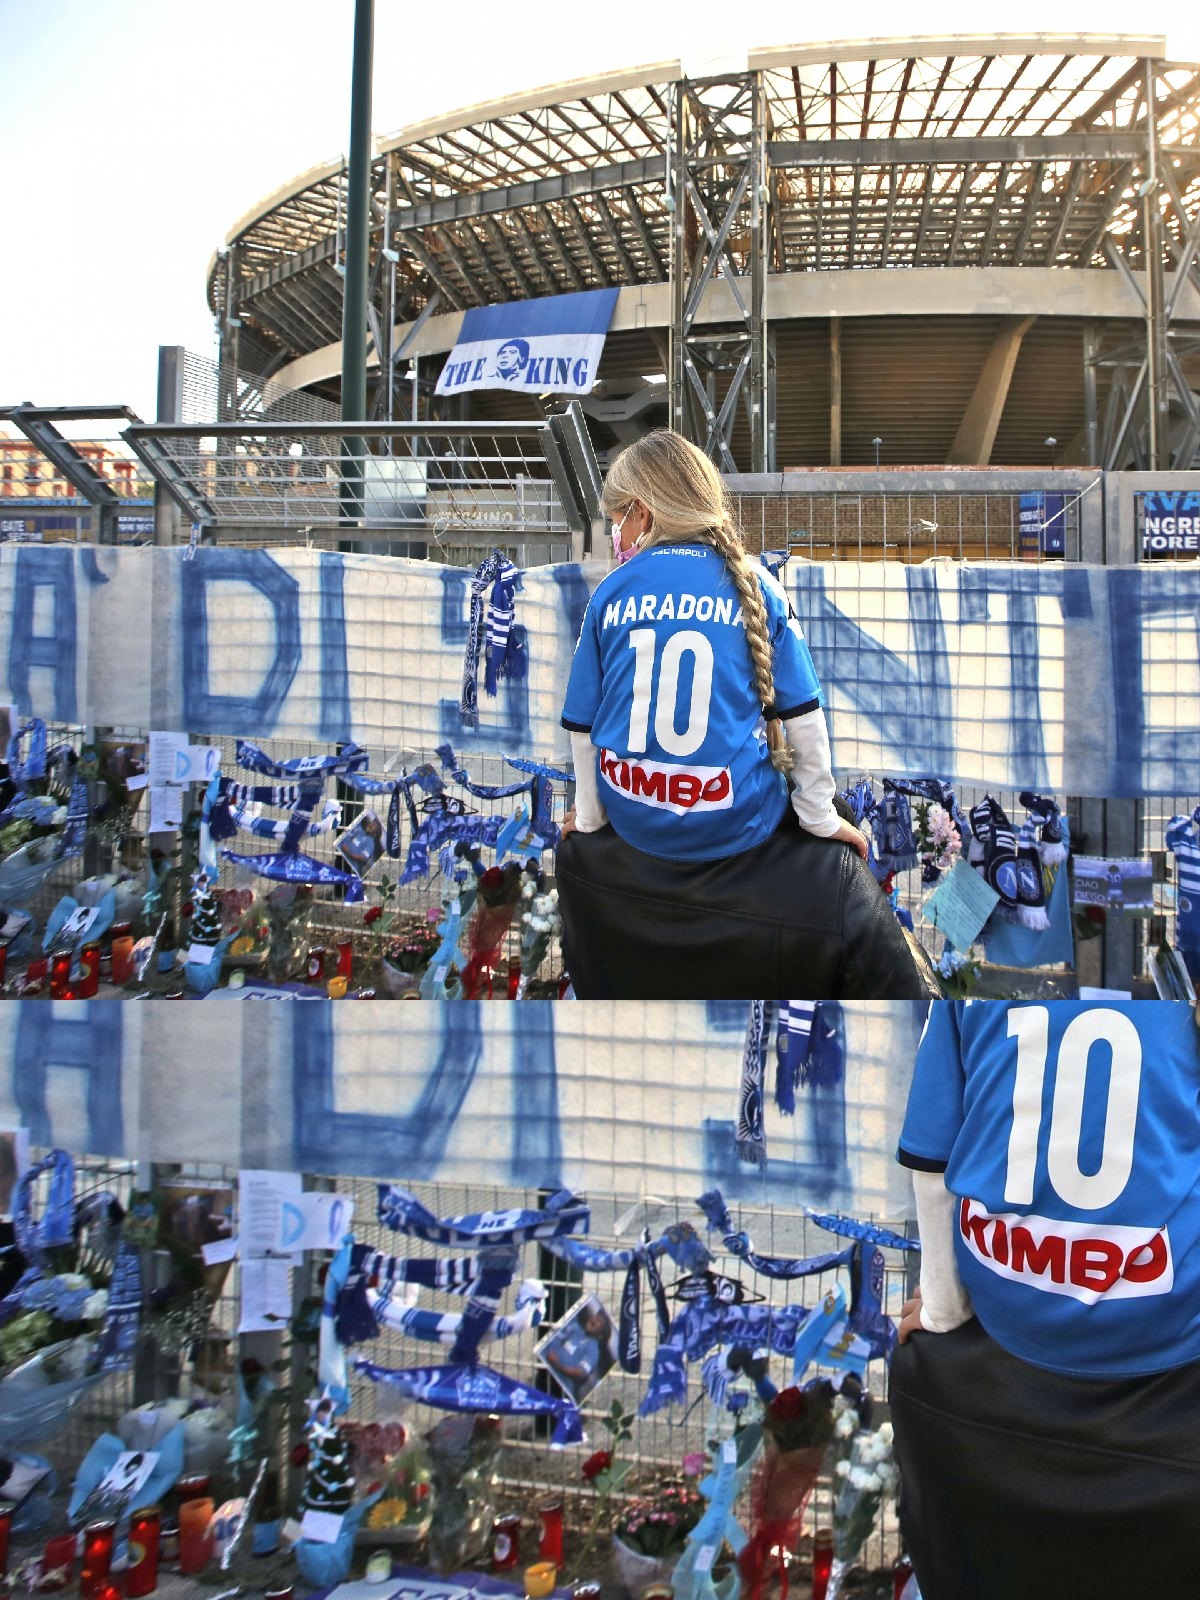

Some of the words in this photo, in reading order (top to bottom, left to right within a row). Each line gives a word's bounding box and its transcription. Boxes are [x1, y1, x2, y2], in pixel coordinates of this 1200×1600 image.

[444, 357, 487, 388] THE
[524, 357, 589, 387] KING
[671, 548, 707, 557] NAPOLI
[603, 593, 748, 630] MARADONA
[627, 628, 715, 757] 10
[600, 748, 730, 808] KIMBO
[1075, 879, 1099, 890] CIAO
[1075, 890, 1106, 902] DIEGO
[1004, 1005, 1142, 1210] 10
[960, 1197, 1168, 1293] KIMBO
